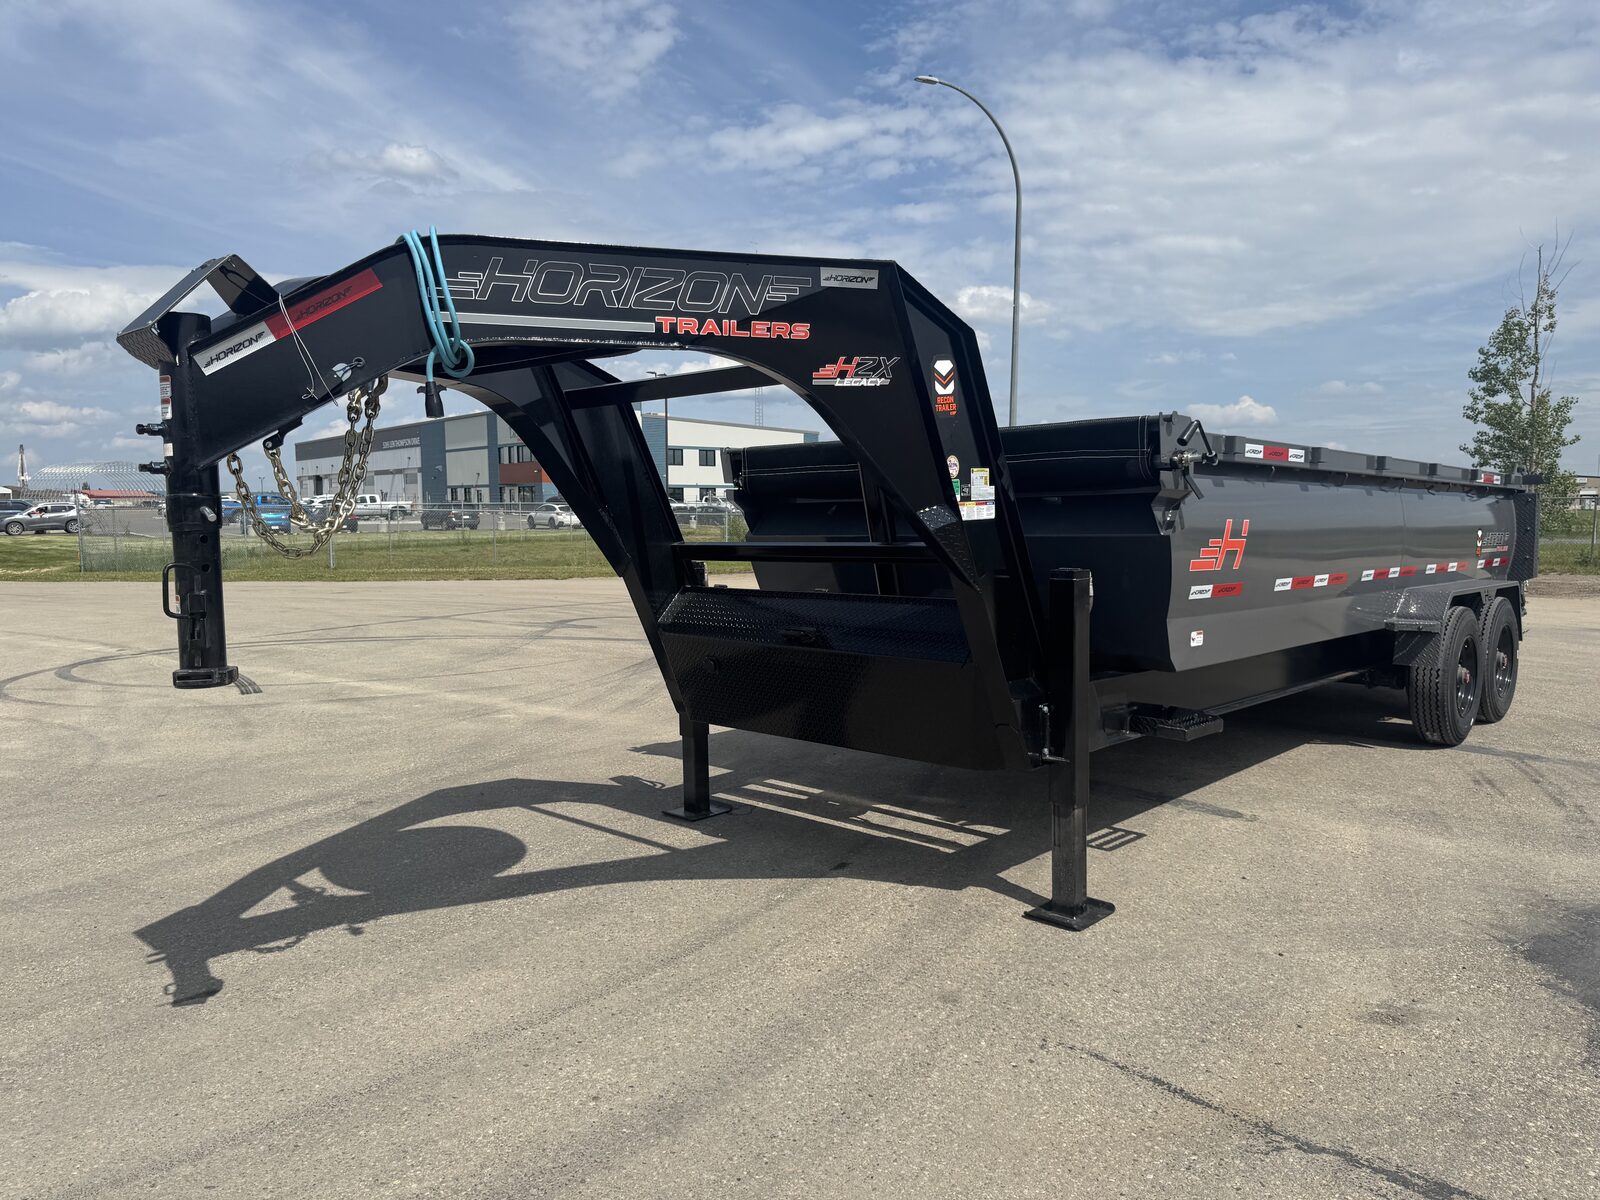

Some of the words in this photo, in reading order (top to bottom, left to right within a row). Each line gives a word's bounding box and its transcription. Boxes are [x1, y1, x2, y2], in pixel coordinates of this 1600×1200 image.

[476, 256, 774, 316] HORIZON
[829, 274, 871, 284] HORIZON
[300, 289, 348, 318] HORIZON
[655, 316, 811, 340] TRAILERS
[210, 332, 260, 366] HORIZON
[834, 378, 885, 387] LEGACY
[935, 403, 957, 412] TRAILER
[936, 396, 955, 404] RECON
